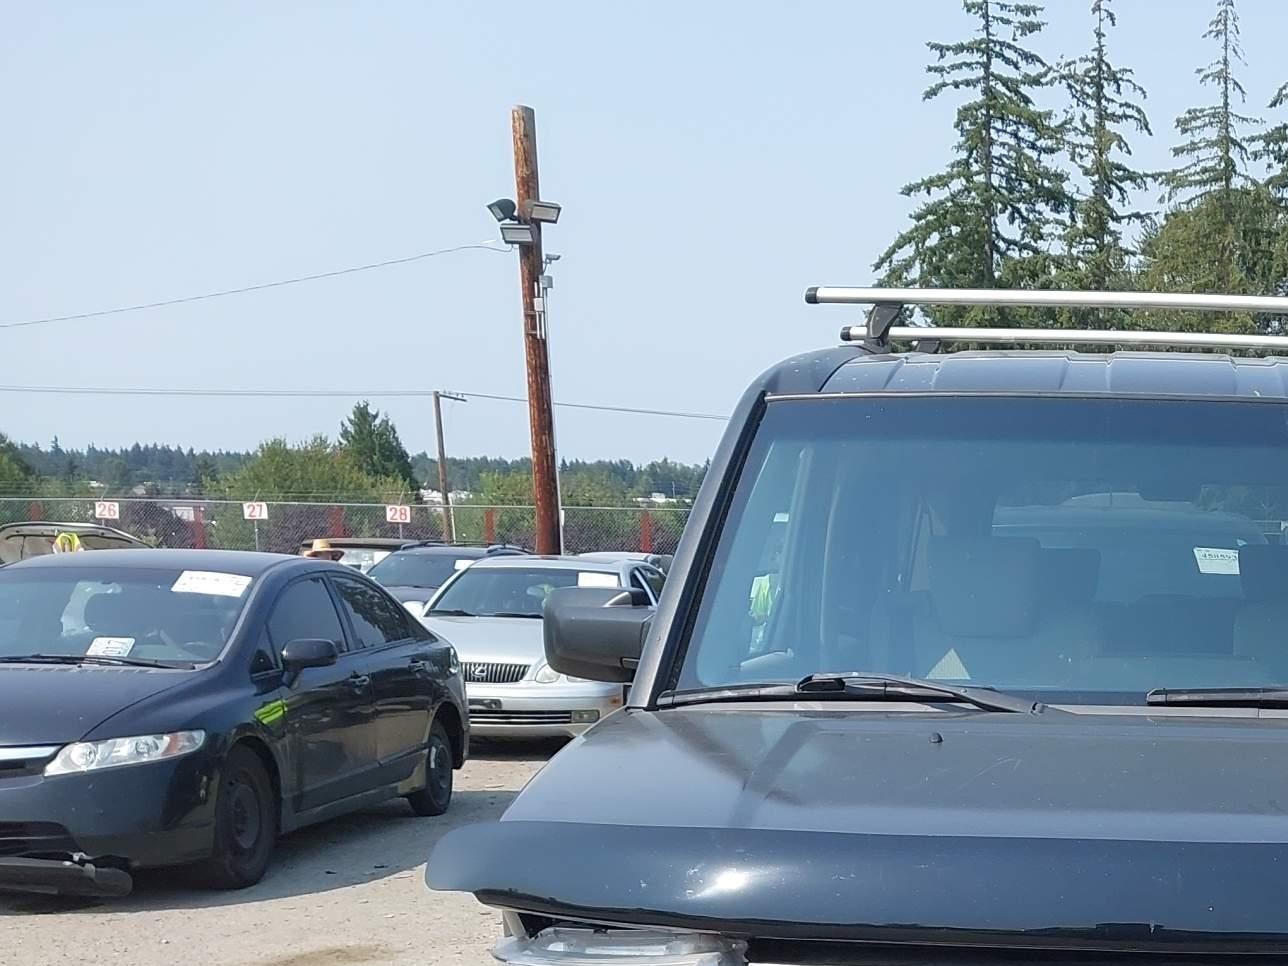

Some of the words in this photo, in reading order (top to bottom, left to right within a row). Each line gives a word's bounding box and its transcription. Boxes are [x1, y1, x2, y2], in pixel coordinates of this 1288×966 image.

[97, 503, 117, 517] 26
[249, 504, 263, 518] 27
[389, 506, 408, 521] 28
